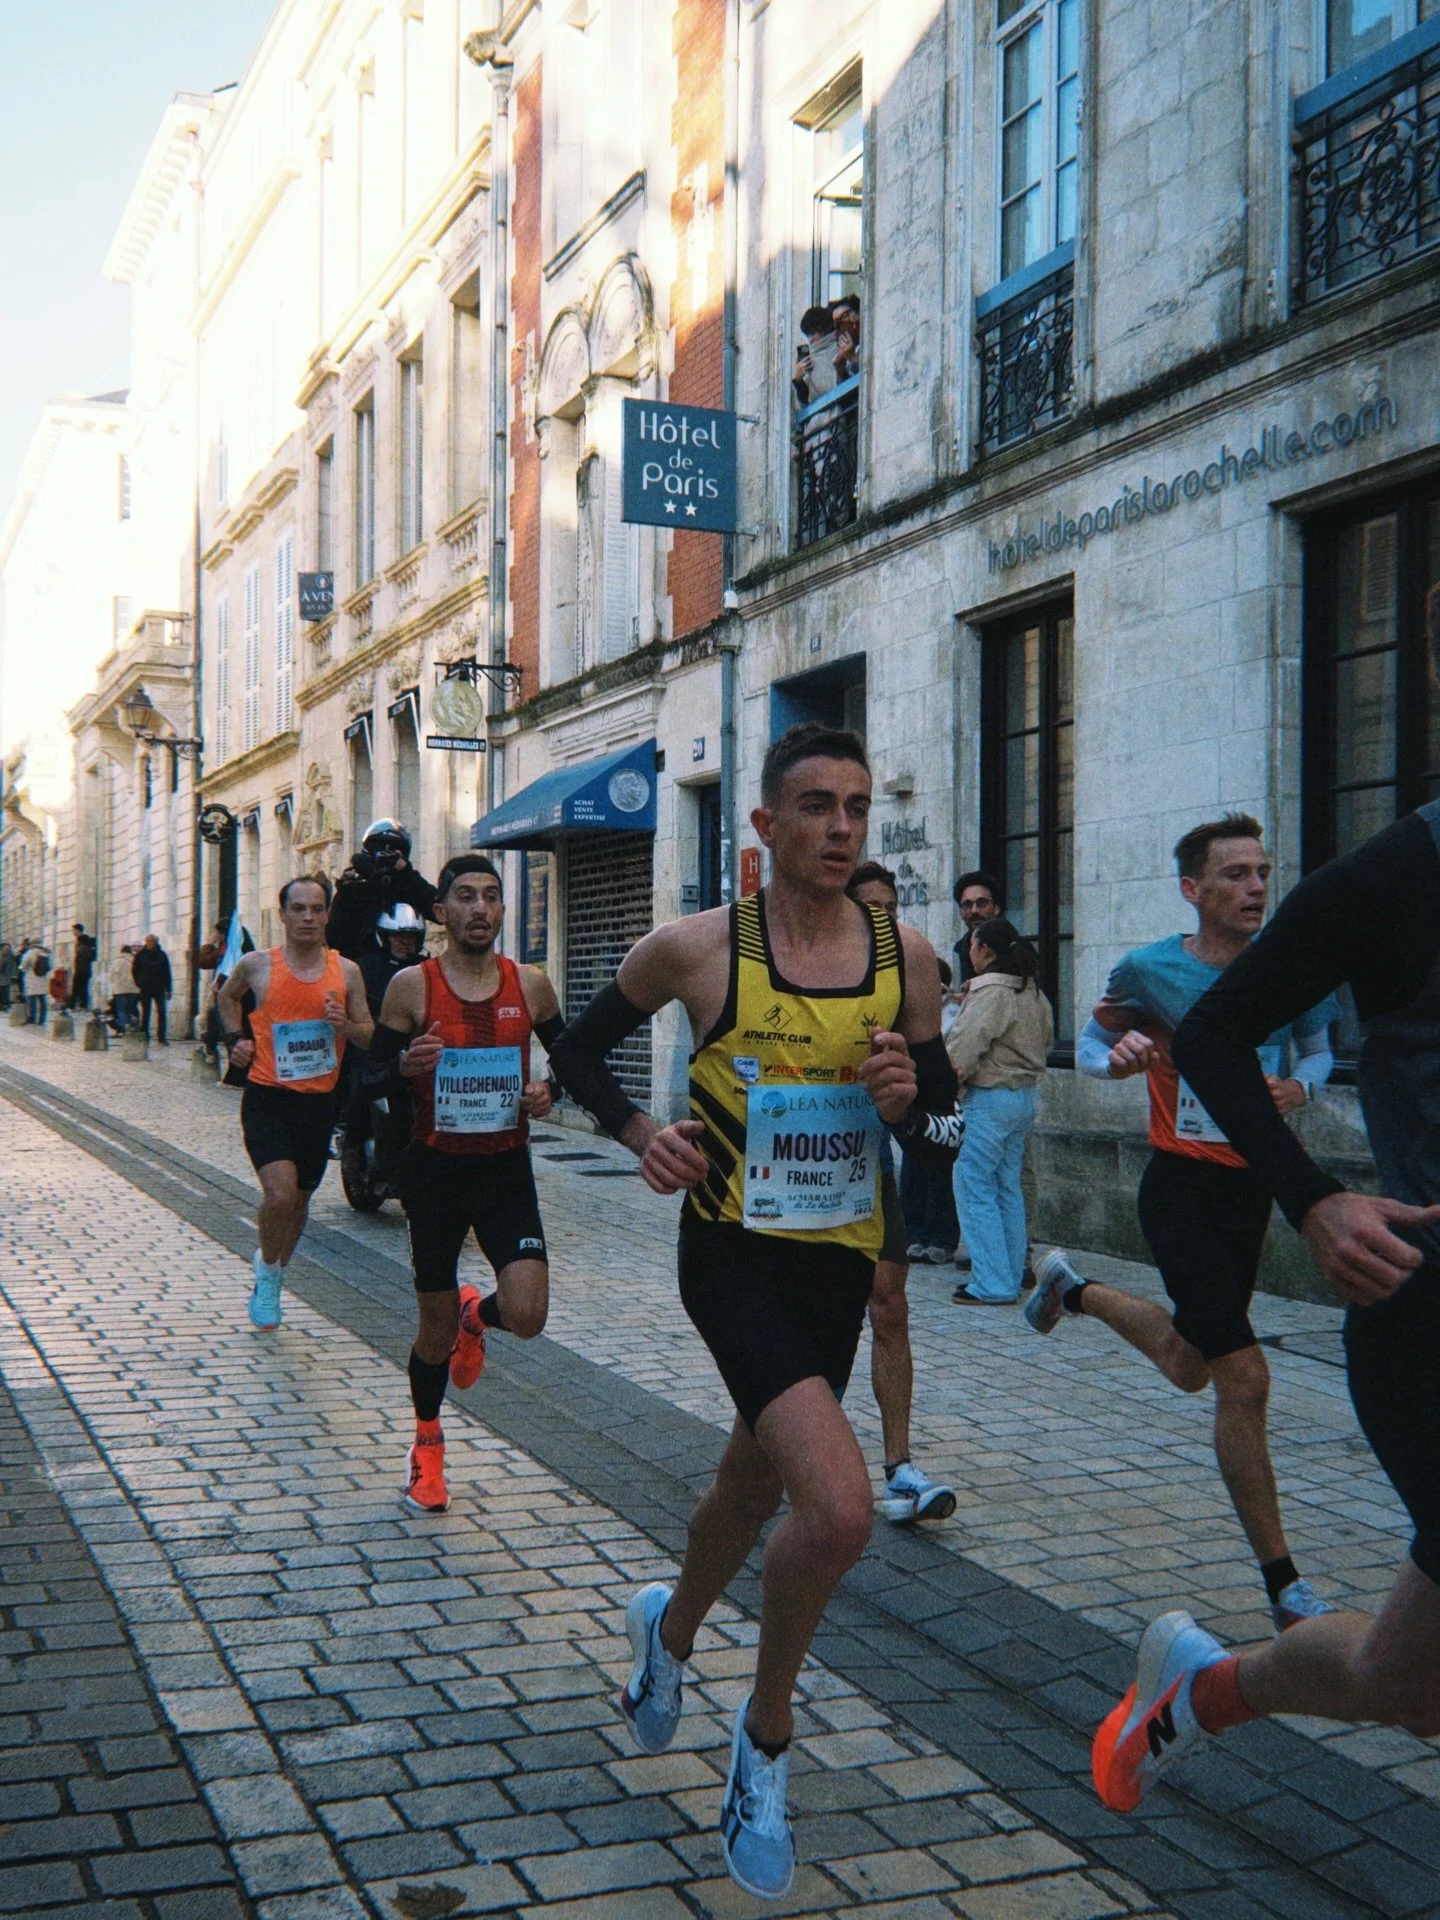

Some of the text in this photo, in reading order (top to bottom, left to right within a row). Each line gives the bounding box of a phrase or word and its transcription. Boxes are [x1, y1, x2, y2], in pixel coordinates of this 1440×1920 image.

[640, 410, 721, 449] Hôtel
[668, 448, 693, 470] de
[642, 462, 719, 498] Paris
[748, 855, 758, 874] H
[896, 873, 931, 906] aris
[287, 1038, 326, 1054] BIRAUD
[742, 1030, 812, 1044] ATHLETIC CLUB
[773, 1065, 836, 1078] INTERSPORT
[438, 1074, 520, 1094] VILLECHENAUD
[459, 1098, 487, 1108] FRANCE
[500, 1093, 514, 1108] 22
[789, 1095, 876, 1111] LÉA NATUR
[772, 1129, 866, 1162] MOUSSU
[786, 1170, 834, 1187] FRANCE
[848, 1157, 867, 1184] 25
